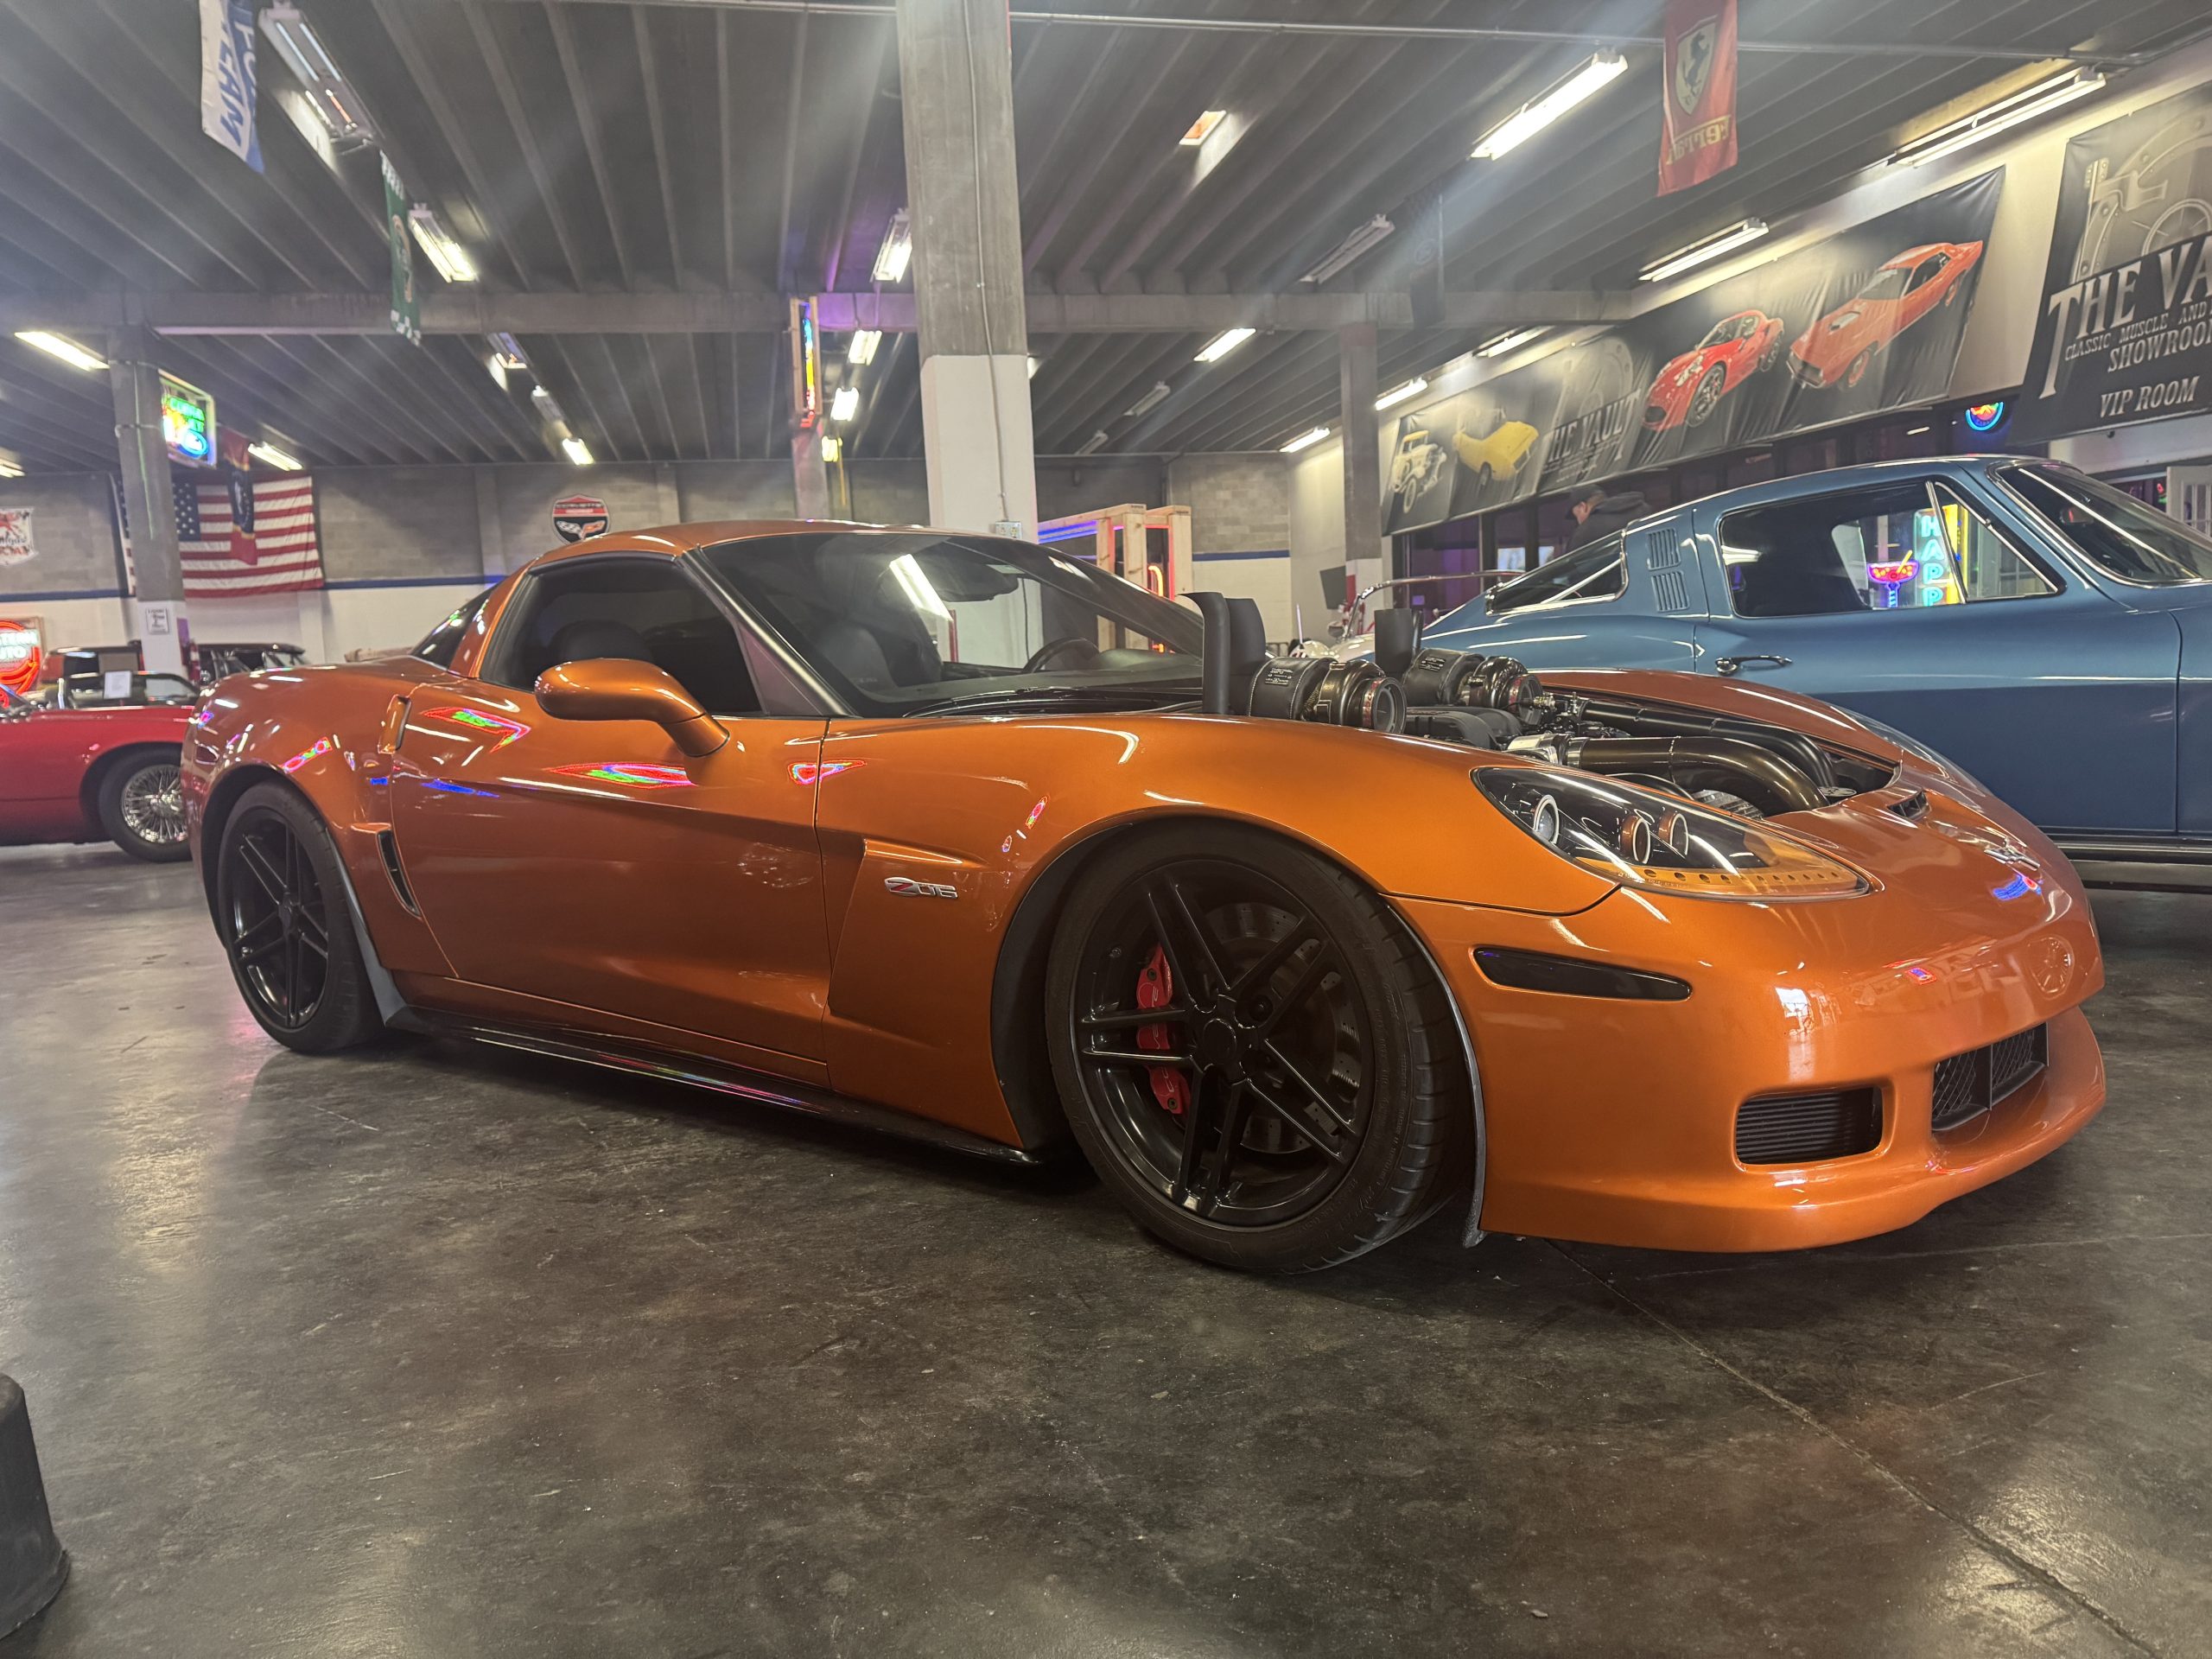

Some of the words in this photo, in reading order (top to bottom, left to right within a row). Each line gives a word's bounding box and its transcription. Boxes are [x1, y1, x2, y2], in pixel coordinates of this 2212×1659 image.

[2039, 262, 2141, 399] THE
[2065, 333, 2112, 361] CLASSIC
[2120, 313, 2169, 344] MUSCLE
[2177, 302, 2208, 325] AND
[2100, 389, 2133, 417] VIP
[2134, 376, 2200, 411] ROOM
[884, 876, 958, 899] Z06
